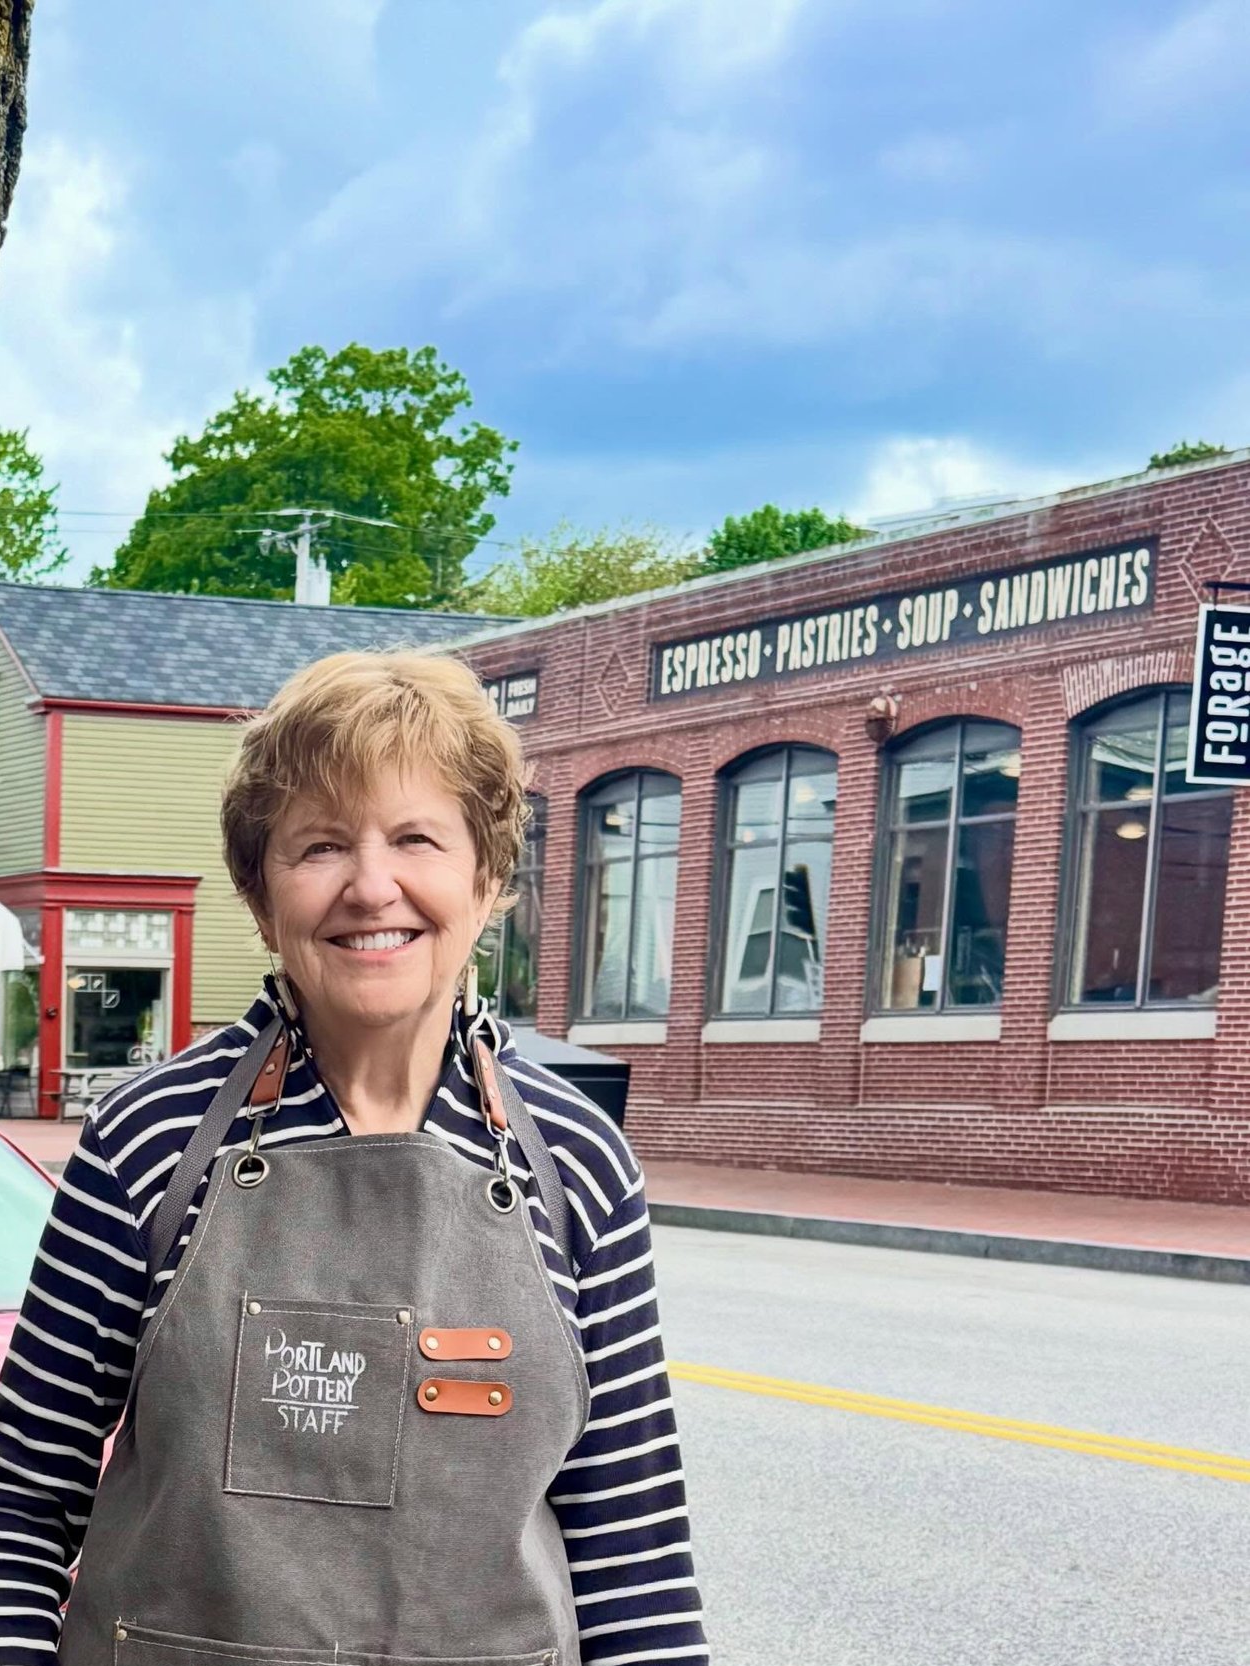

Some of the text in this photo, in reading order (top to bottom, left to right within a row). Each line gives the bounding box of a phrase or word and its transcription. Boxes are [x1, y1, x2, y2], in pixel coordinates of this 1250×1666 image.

[661, 548, 1150, 695] ESPRESSO PASTRIES SOUP SANDWICHES
[265, 1326, 366, 1376] PORTLAND
[272, 1367, 359, 1403] POTTERY
[277, 1404, 349, 1435] STAFF
